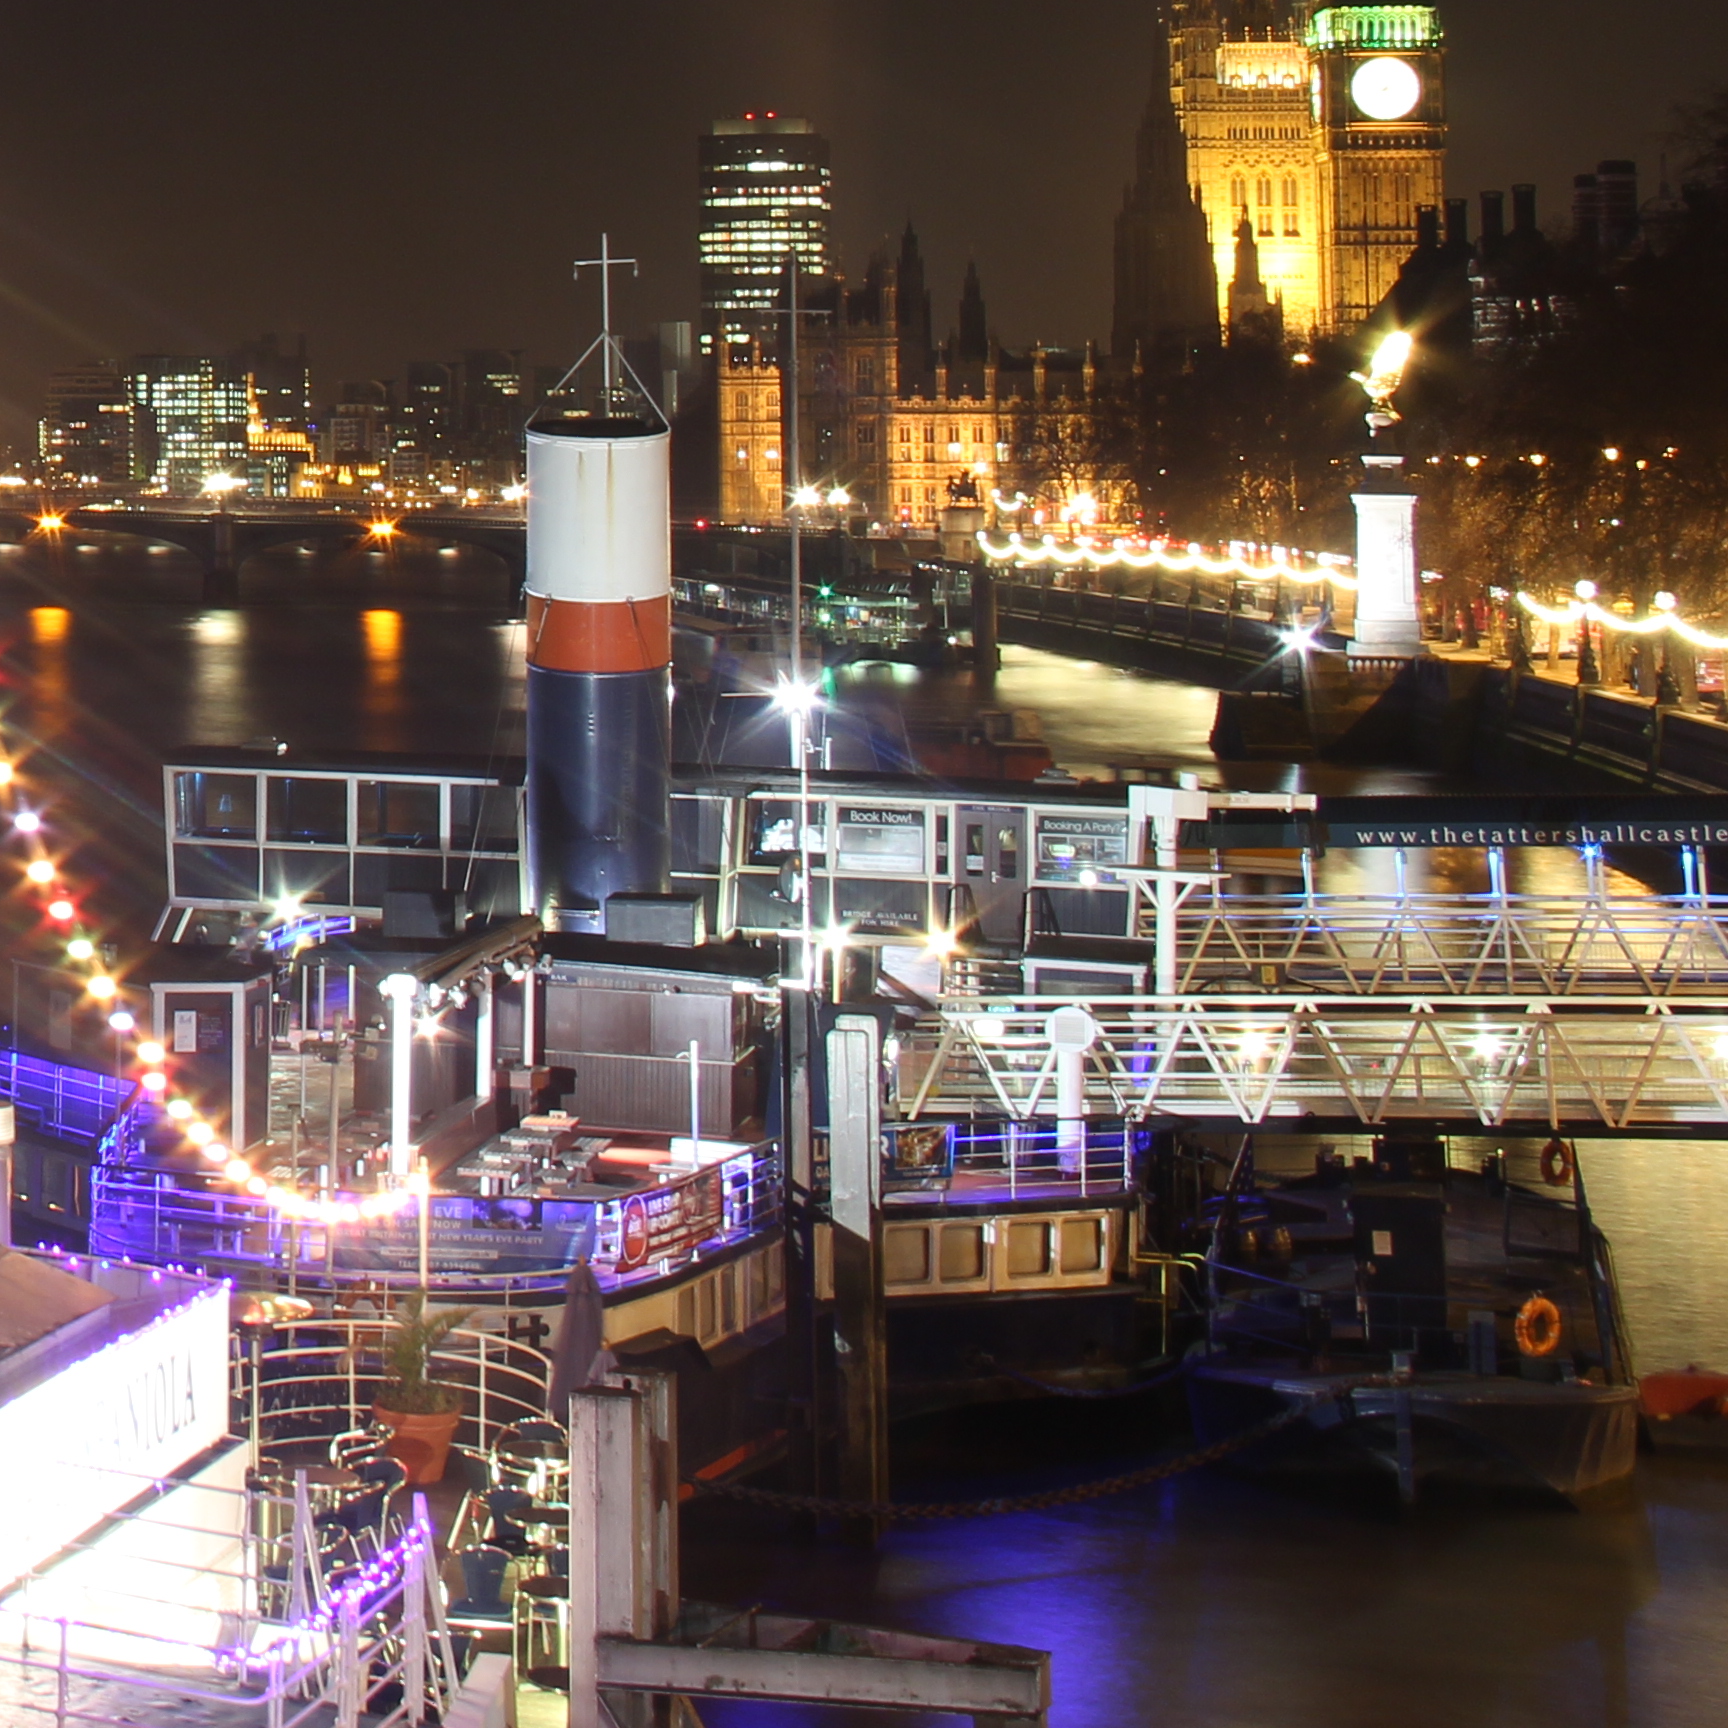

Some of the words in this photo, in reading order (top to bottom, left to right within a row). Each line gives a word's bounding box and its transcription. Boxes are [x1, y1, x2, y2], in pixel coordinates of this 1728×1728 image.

[850, 810, 880, 823] Book
[882, 811, 912, 824] Now!
[1044, 820, 1082, 833] Booking
[1082, 822, 1091, 831] A
[1356, 824, 1728, 844] www.thetattershallcastle
[842, 910, 871, 918] BRIDGE
[875, 912, 918, 921] AVAILABLE
[434, 1205, 462, 1219] EVE
[433, 1220, 462, 1230] NOW
